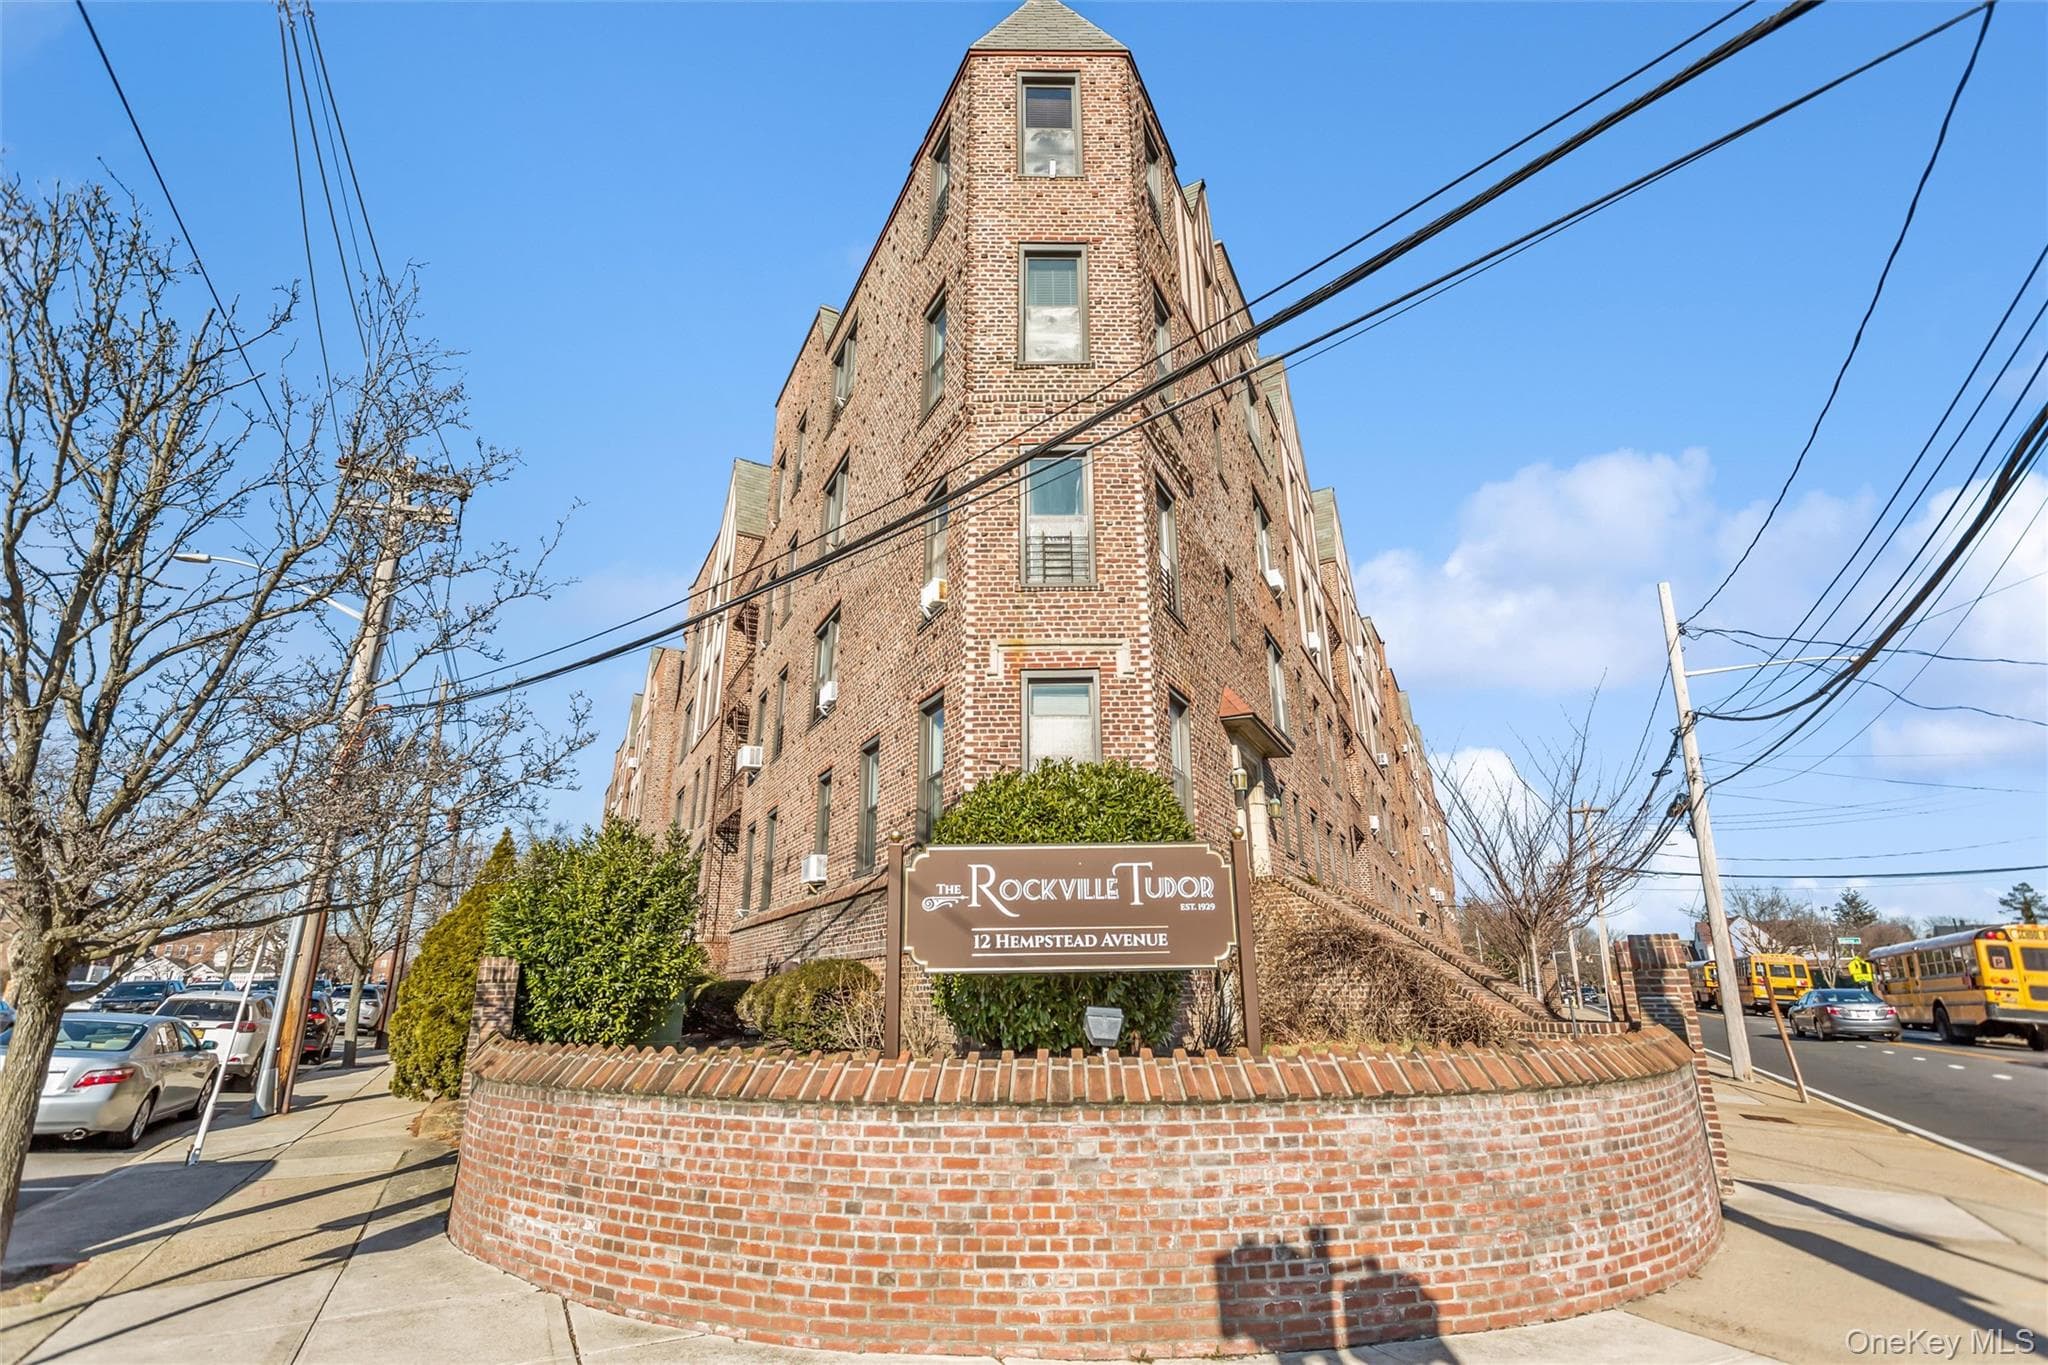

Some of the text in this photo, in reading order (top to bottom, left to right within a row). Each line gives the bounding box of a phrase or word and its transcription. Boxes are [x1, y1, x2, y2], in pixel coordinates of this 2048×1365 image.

[935, 861, 1215, 918] THE ROCKVILLE TUDOR
[1180, 902, 1216, 911] EST. 1929
[973, 932, 1169, 949] 12 HEMPSTEAD AVENUE
